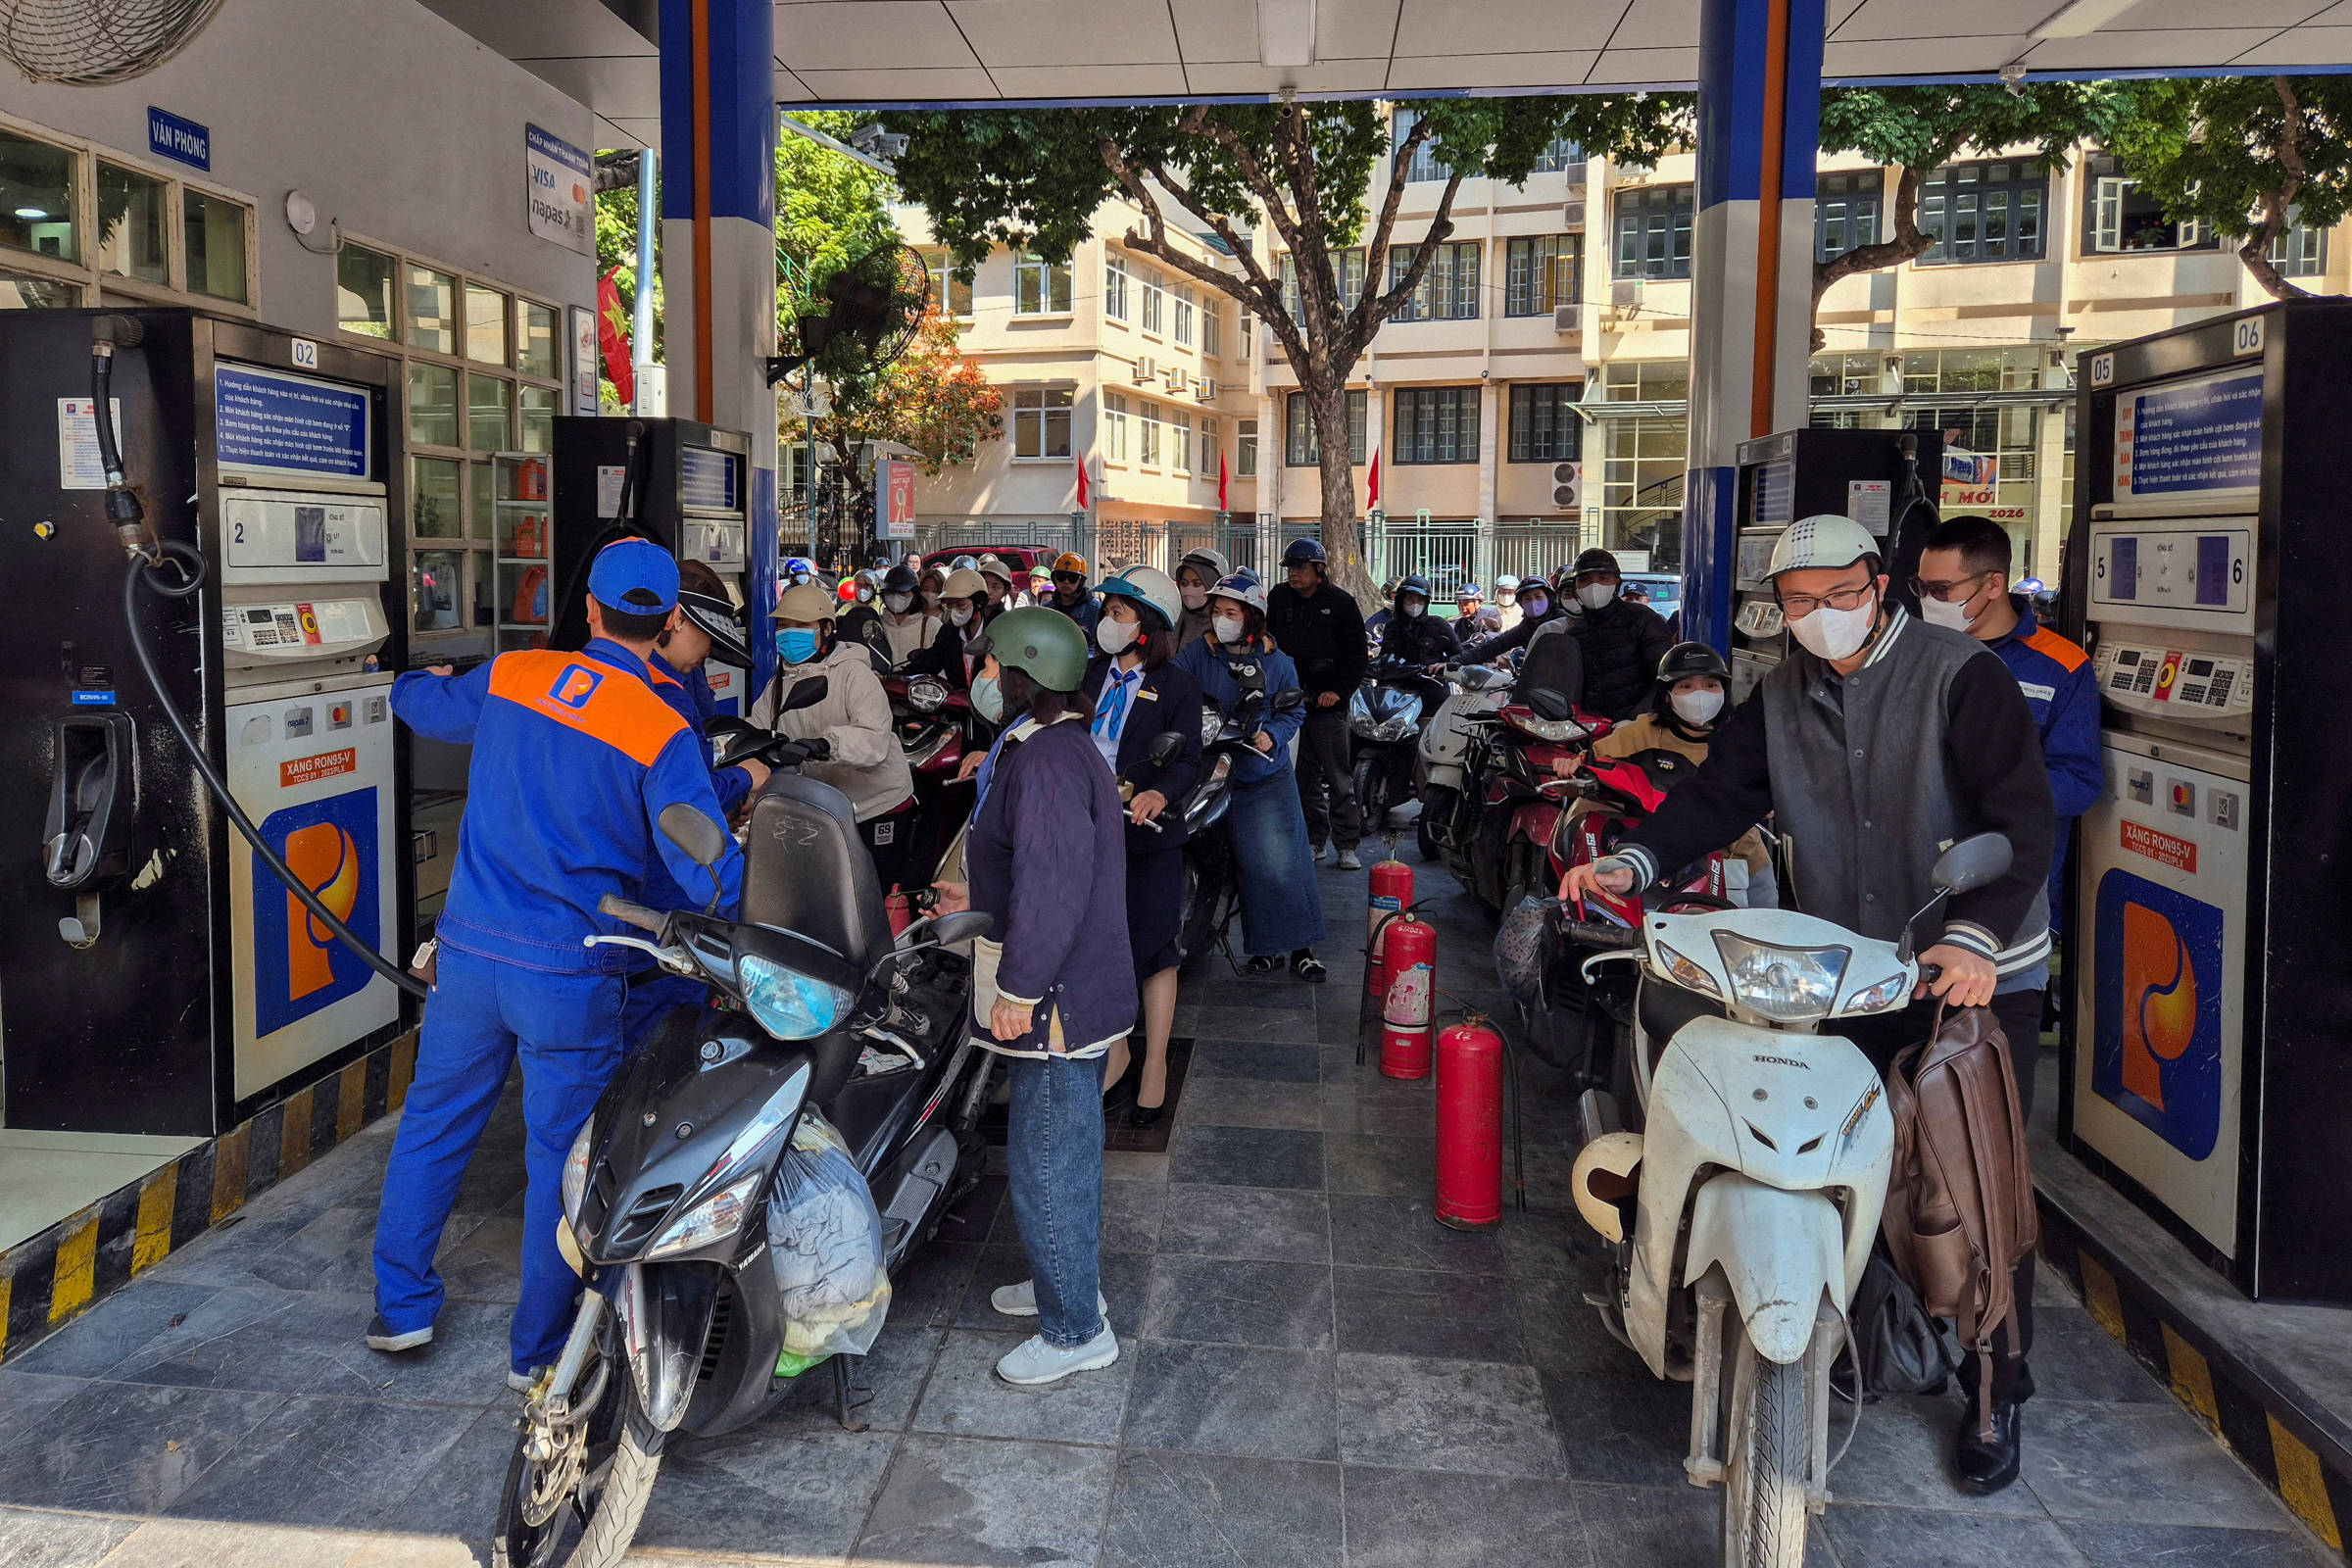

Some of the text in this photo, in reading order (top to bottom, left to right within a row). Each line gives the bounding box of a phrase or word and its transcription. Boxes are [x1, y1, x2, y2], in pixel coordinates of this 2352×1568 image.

[153, 119, 206, 159] VĂN PHÒNG
[532, 165, 555, 189] VISA
[532, 198, 563, 225] napas
[2239, 321, 2258, 350] 06
[297, 343, 314, 365] 02
[2095, 359, 2110, 381] 05
[1988, 508, 2025, 517] 2026
[235, 522, 243, 543] 2
[2097, 557, 2105, 578] 5
[2232, 559, 2242, 584] 6
[287, 752, 351, 776] XĂNG RON95-V
[294, 774, 309, 784] TCCS
[878, 824, 891, 835] 69
[1586, 833, 1595, 847] 29
[2127, 825, 2191, 858] XĂNG RON95-V
[2132, 842, 2146, 855] TCCS
[1711, 859, 1721, 874] 29
[1454, 1031, 1472, 1041] 12
[1753, 1054, 1811, 1070] HONDA
[739, 1241, 766, 1270] YAMAHA
